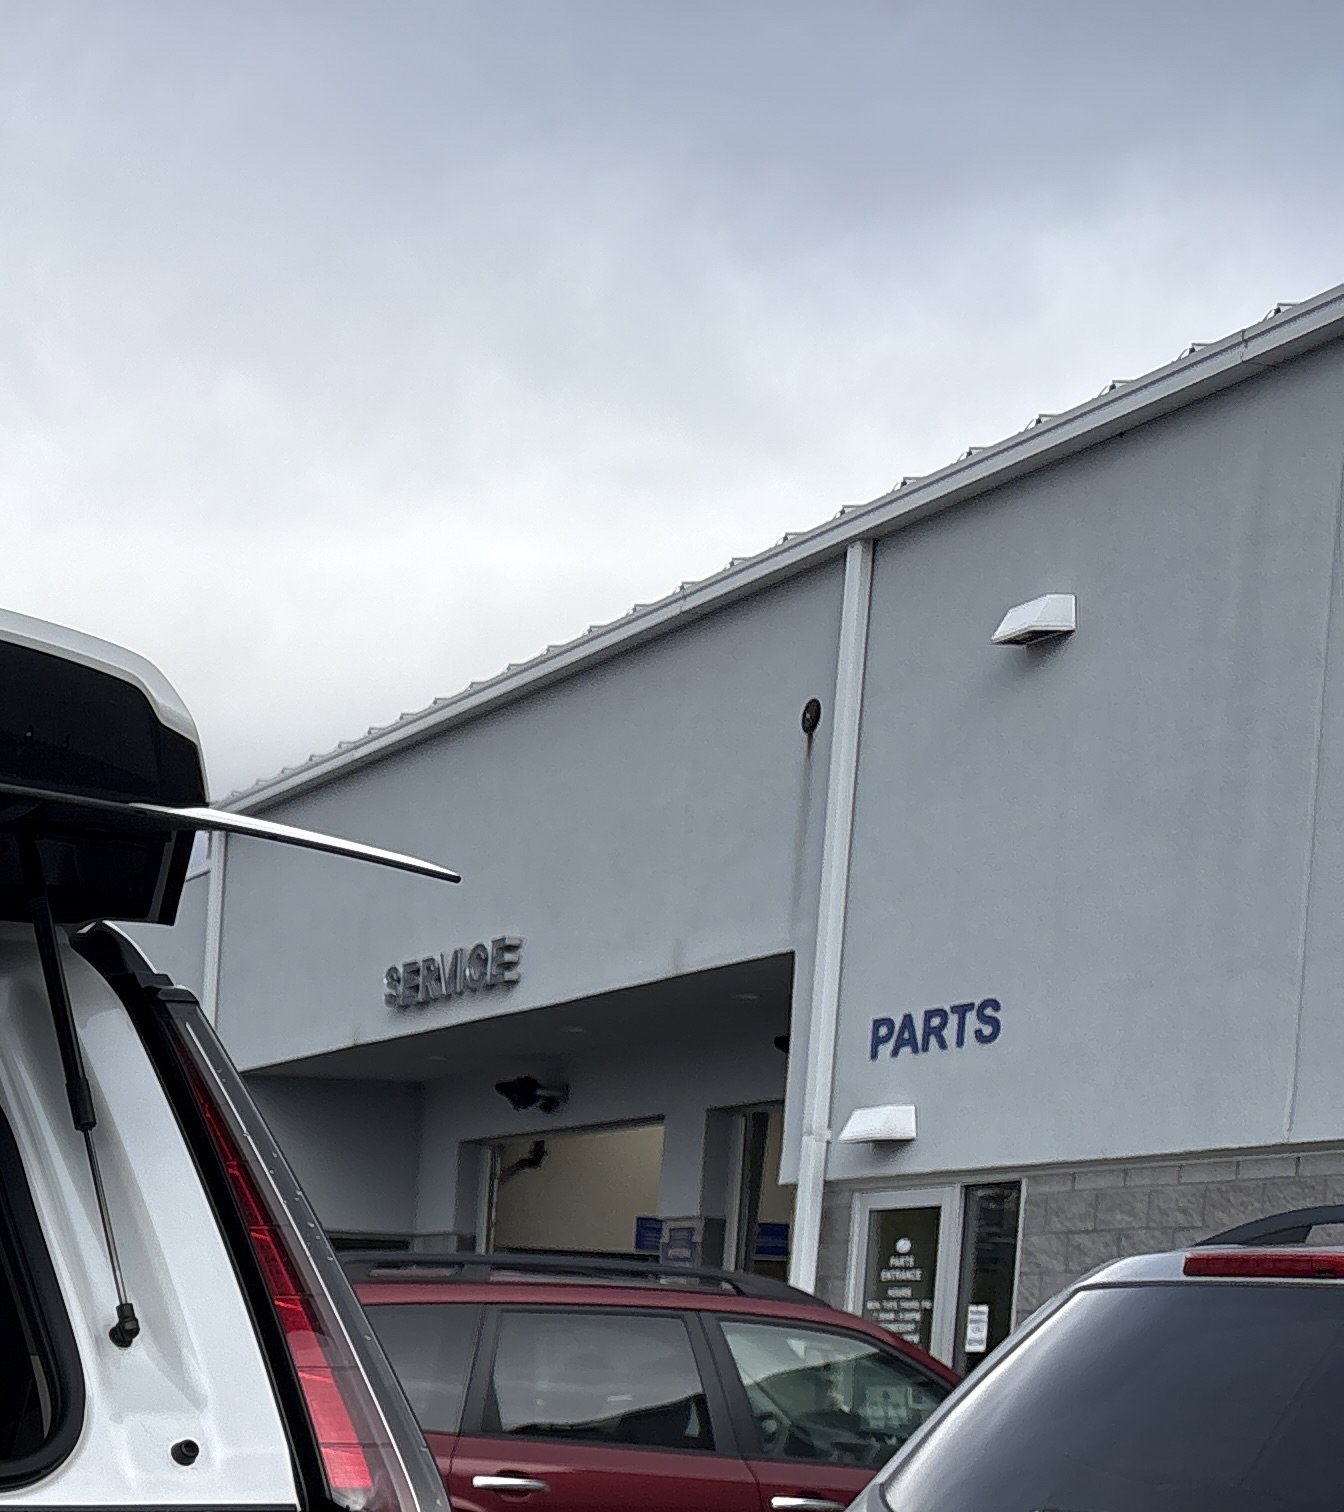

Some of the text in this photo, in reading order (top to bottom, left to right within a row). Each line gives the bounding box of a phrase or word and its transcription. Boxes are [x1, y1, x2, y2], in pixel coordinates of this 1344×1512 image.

[383, 935, 523, 1008] SERVICE
[869, 998, 1001, 1061] PARTS
[880, 1268, 922, 1282] ENTRANCE
[889, 1255, 914, 1268] PARTS
